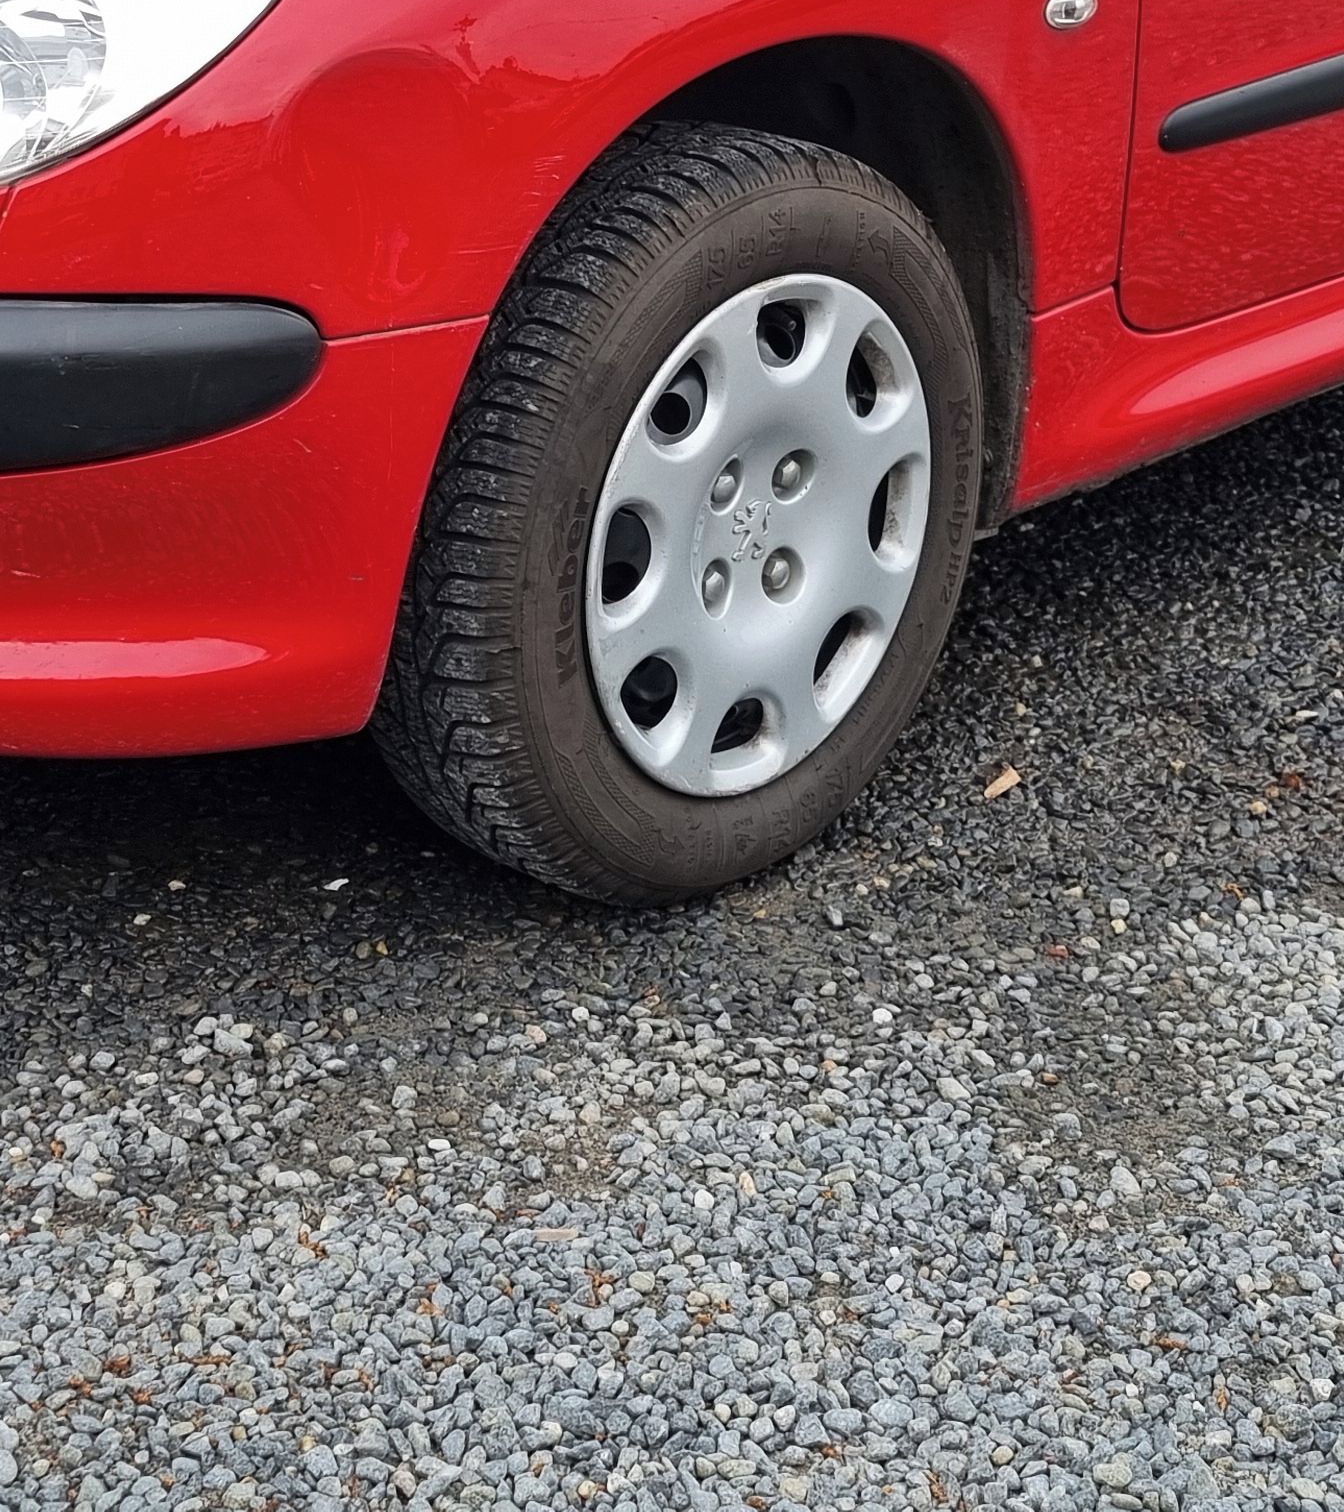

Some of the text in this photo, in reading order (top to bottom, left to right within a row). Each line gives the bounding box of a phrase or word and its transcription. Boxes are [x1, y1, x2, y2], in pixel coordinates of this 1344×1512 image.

[706, 208, 787, 290] 175 65 R14
[555, 484, 590, 691] Kleber
[938, 551, 962, 607] HP2
